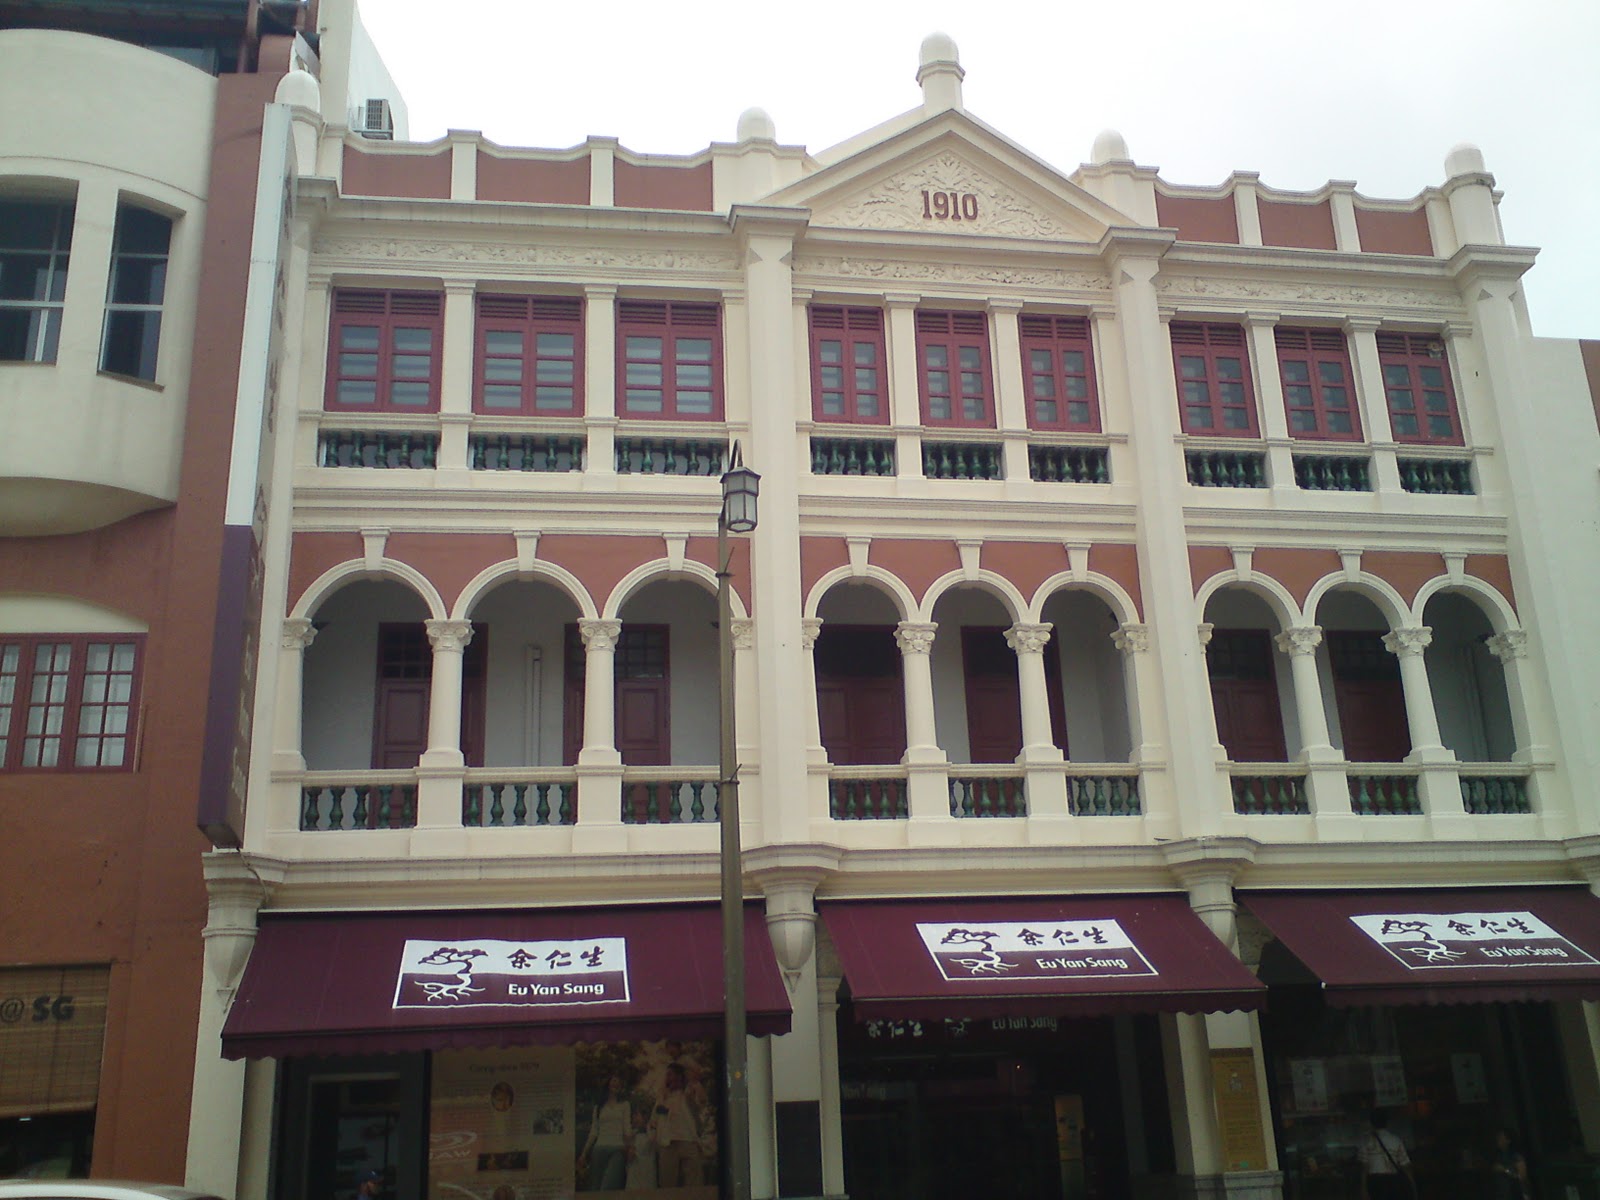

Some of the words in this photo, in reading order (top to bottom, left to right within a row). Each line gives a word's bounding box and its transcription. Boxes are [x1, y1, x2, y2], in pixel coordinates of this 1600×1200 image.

[921, 190, 979, 222] 1910
[1017, 927, 1108, 946] 余仁生
[507, 945, 604, 969] 余仁生
[1479, 947, 1503, 957] Eu
[1500, 946, 1528, 957] Yan
[1524, 945, 1568, 957] Sang
[1036, 958, 1057, 969] Eu
[1055, 958, 1085, 968] Yan
[1085, 957, 1128, 969] Sang
[508, 983, 528, 995] Eu
[530, 983, 560, 995] Yan
[563, 983, 605, 995] Sang
[0, 997, 25, 1023] @
[32, 994, 76, 1022] SG
